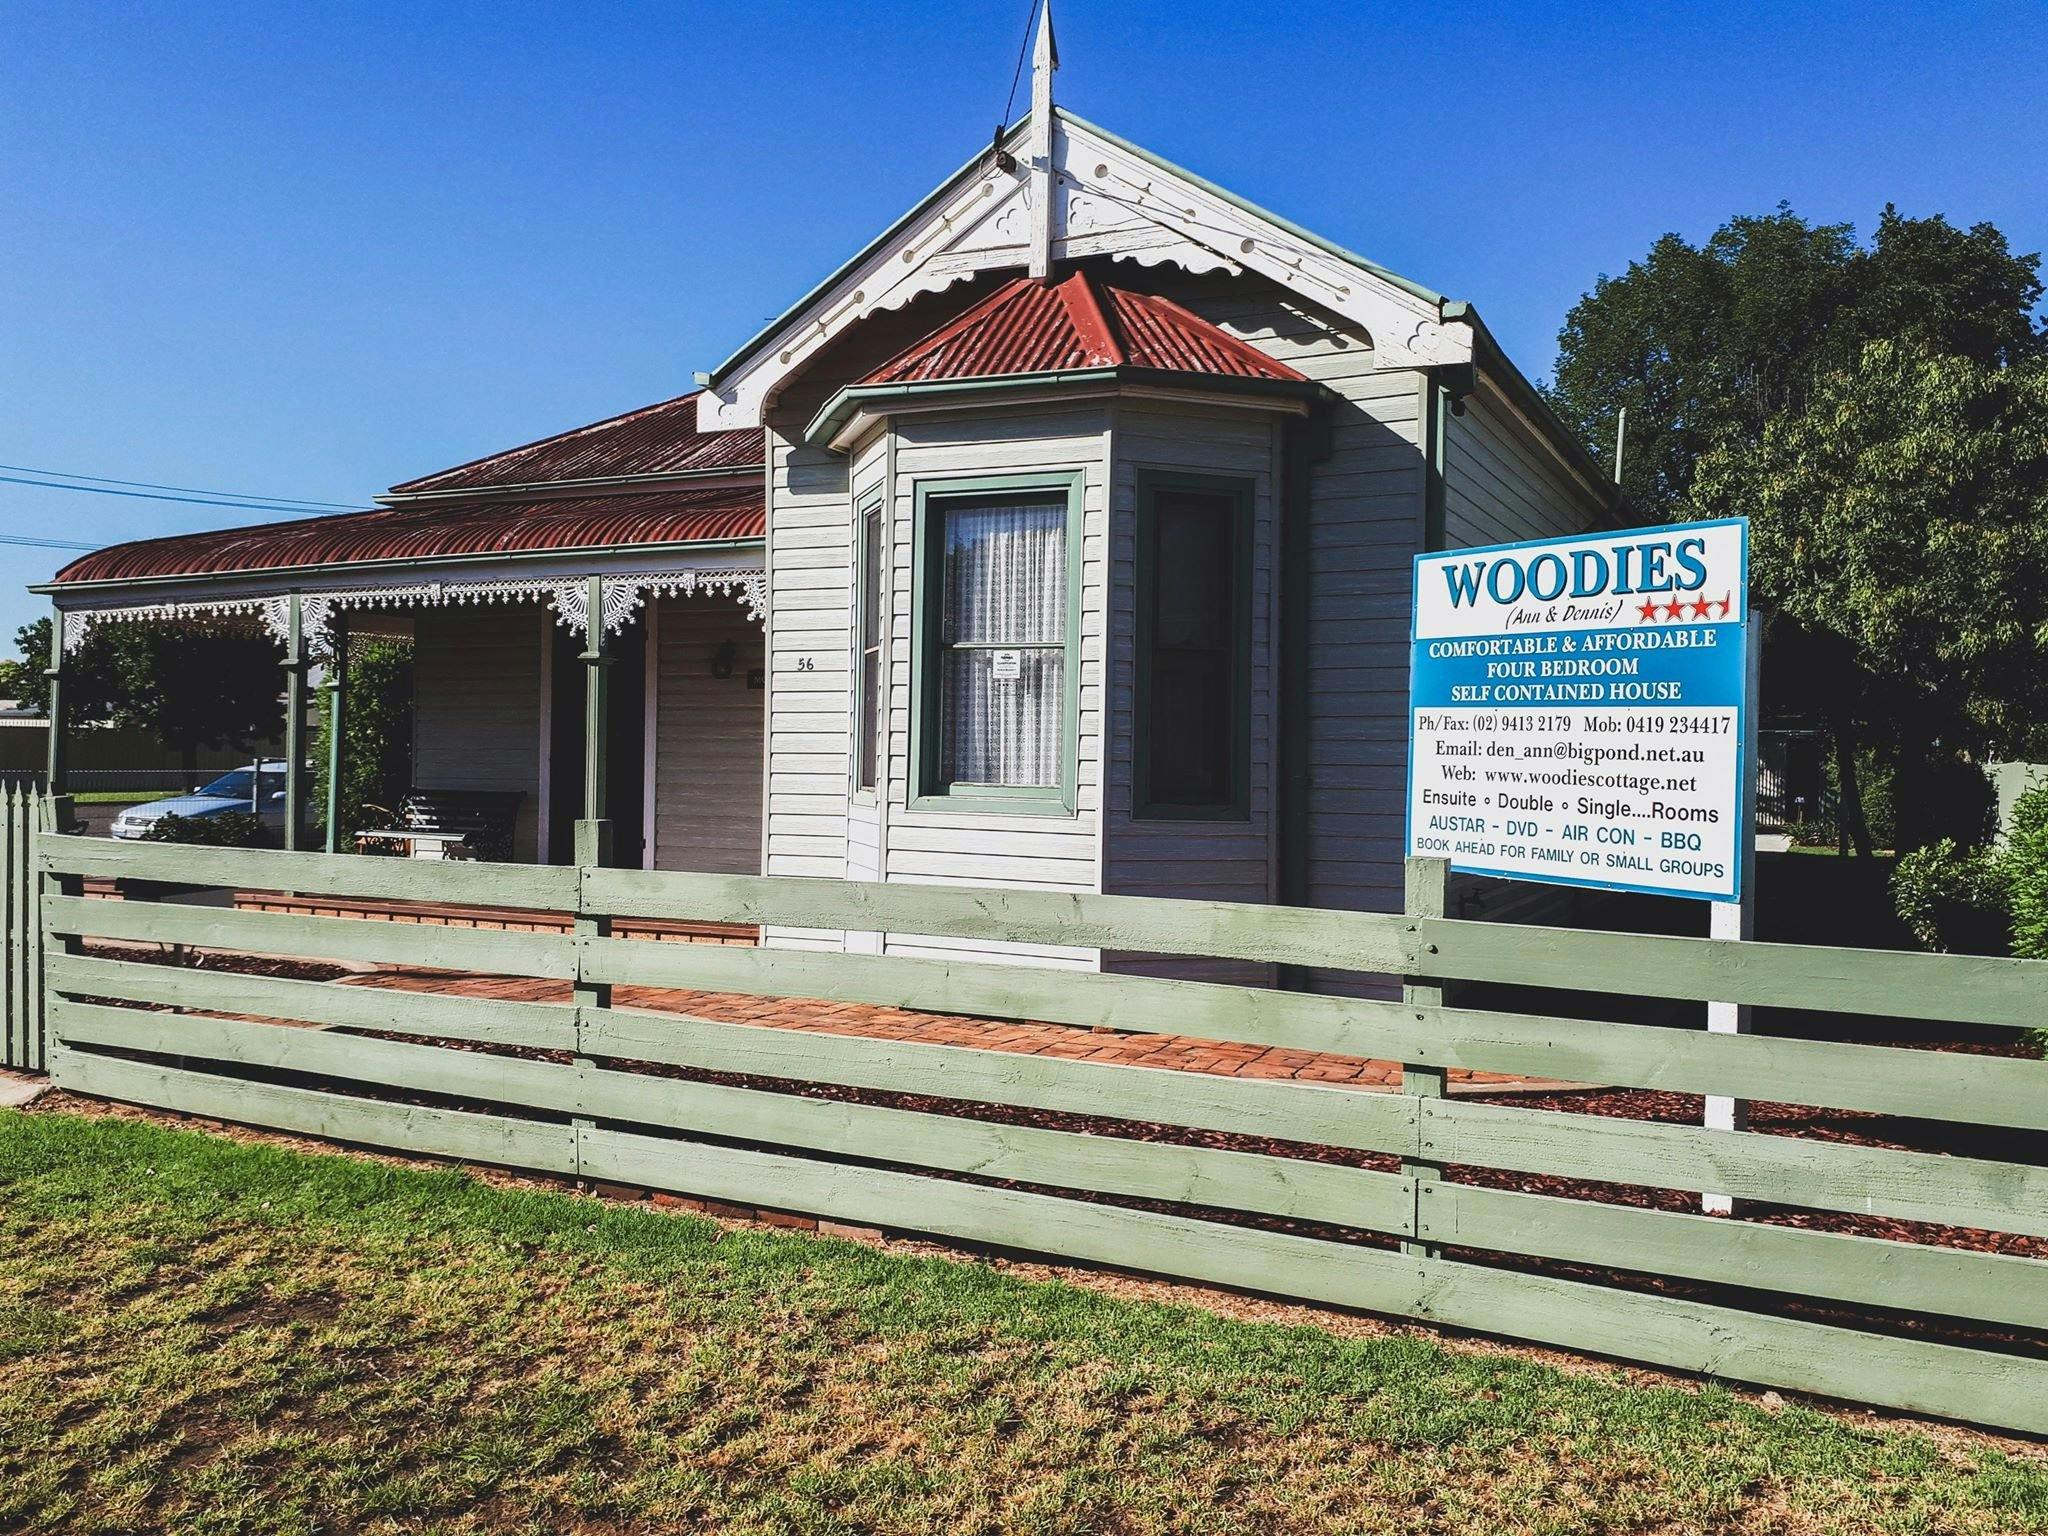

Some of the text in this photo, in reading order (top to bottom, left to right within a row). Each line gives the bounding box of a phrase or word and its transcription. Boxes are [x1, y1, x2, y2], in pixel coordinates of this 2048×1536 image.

[1441, 538, 1707, 609] WOODIES
[1506, 599, 1623, 630] (Ann & Dennis)
[1429, 629, 1717, 658] COMFORTABLE & AFFORDABLE
[797, 657, 814, 671] 56
[1487, 658, 1639, 678] FOUR BEDROOM
[1452, 682, 1681, 701] SELF CONTAINED HOUSE
[1419, 715, 1730, 734] Ph/Fax: (02) 9413 2179 Mob: 0419 234417
[1436, 740, 1704, 765] Email: den_ann@bigpond.net.au
[1441, 765, 1696, 795] Web: www.woodiescottage.net
[1423, 789, 1476, 806] Ensuite
[1498, 793, 1553, 811] Double
[1429, 816, 1485, 833] AUSTAR
[1507, 820, 1538, 837] DVD
[1562, 825, 1588, 841] AIR
[1597, 827, 1635, 845] CON
[1661, 832, 1701, 851] BBQ
[1417, 838, 1724, 878] BOOK AHEAD FOR FAMILY OR SMALL GROUPS
